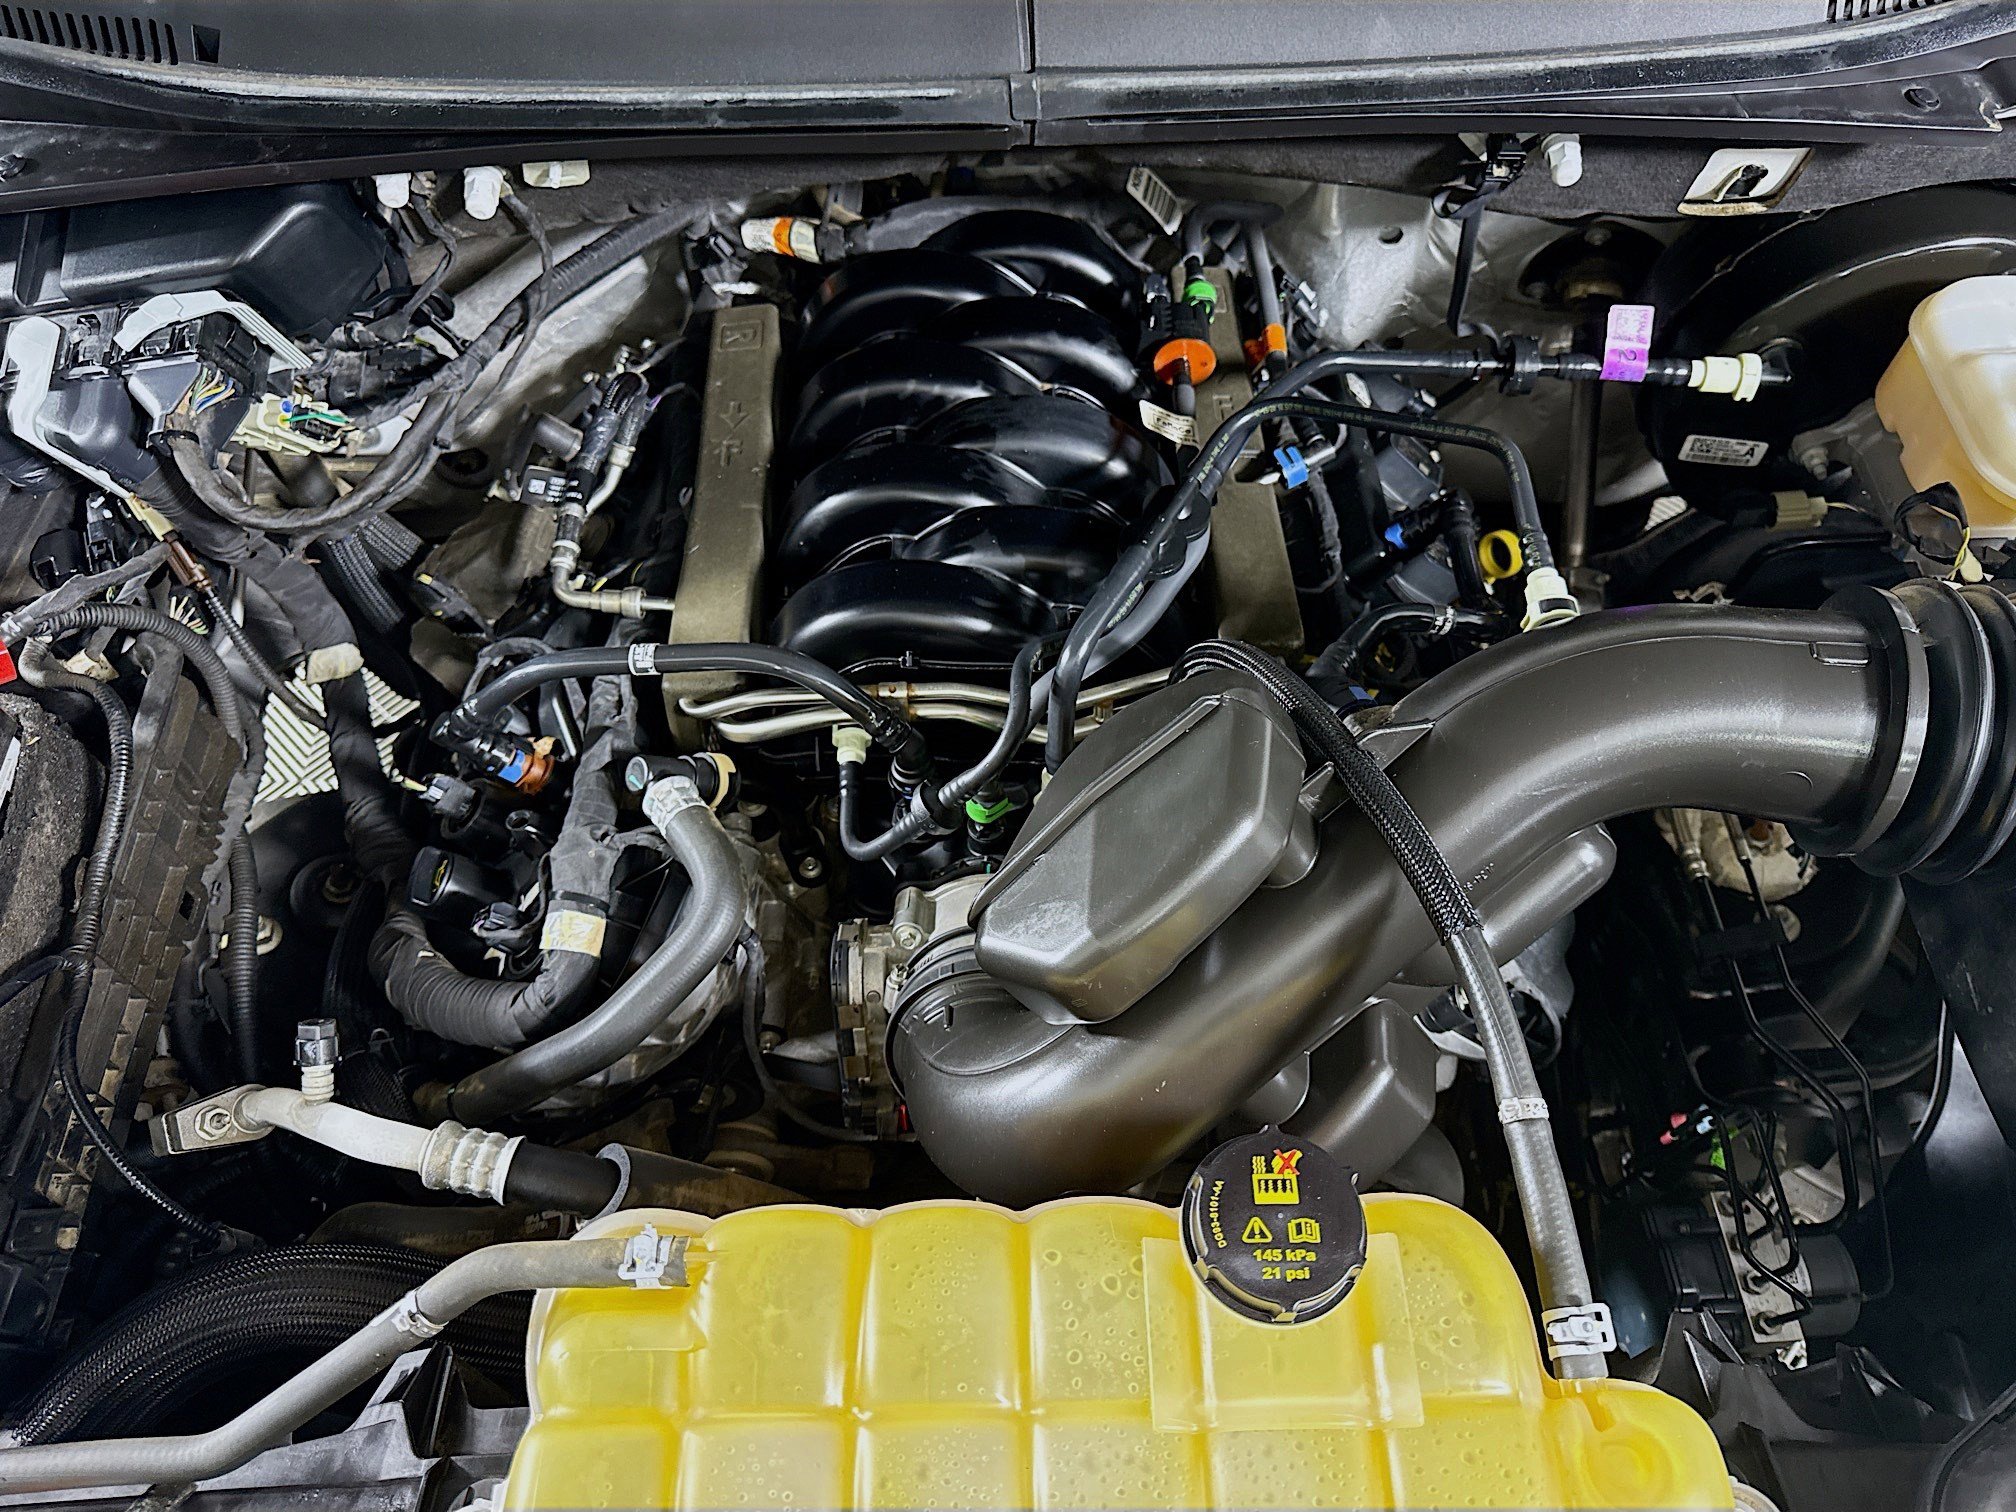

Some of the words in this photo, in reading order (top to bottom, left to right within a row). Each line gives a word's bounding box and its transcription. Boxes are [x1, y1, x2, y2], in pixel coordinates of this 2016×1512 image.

[1617, 349, 1637, 363] 2
[1743, 447, 1755, 458] A
[1253, 1249, 1282, 1262] 145
[1286, 1249, 1317, 1262] kPa
[1262, 1266, 1281, 1280] 21
[1286, 1266, 1310, 1282] psi
